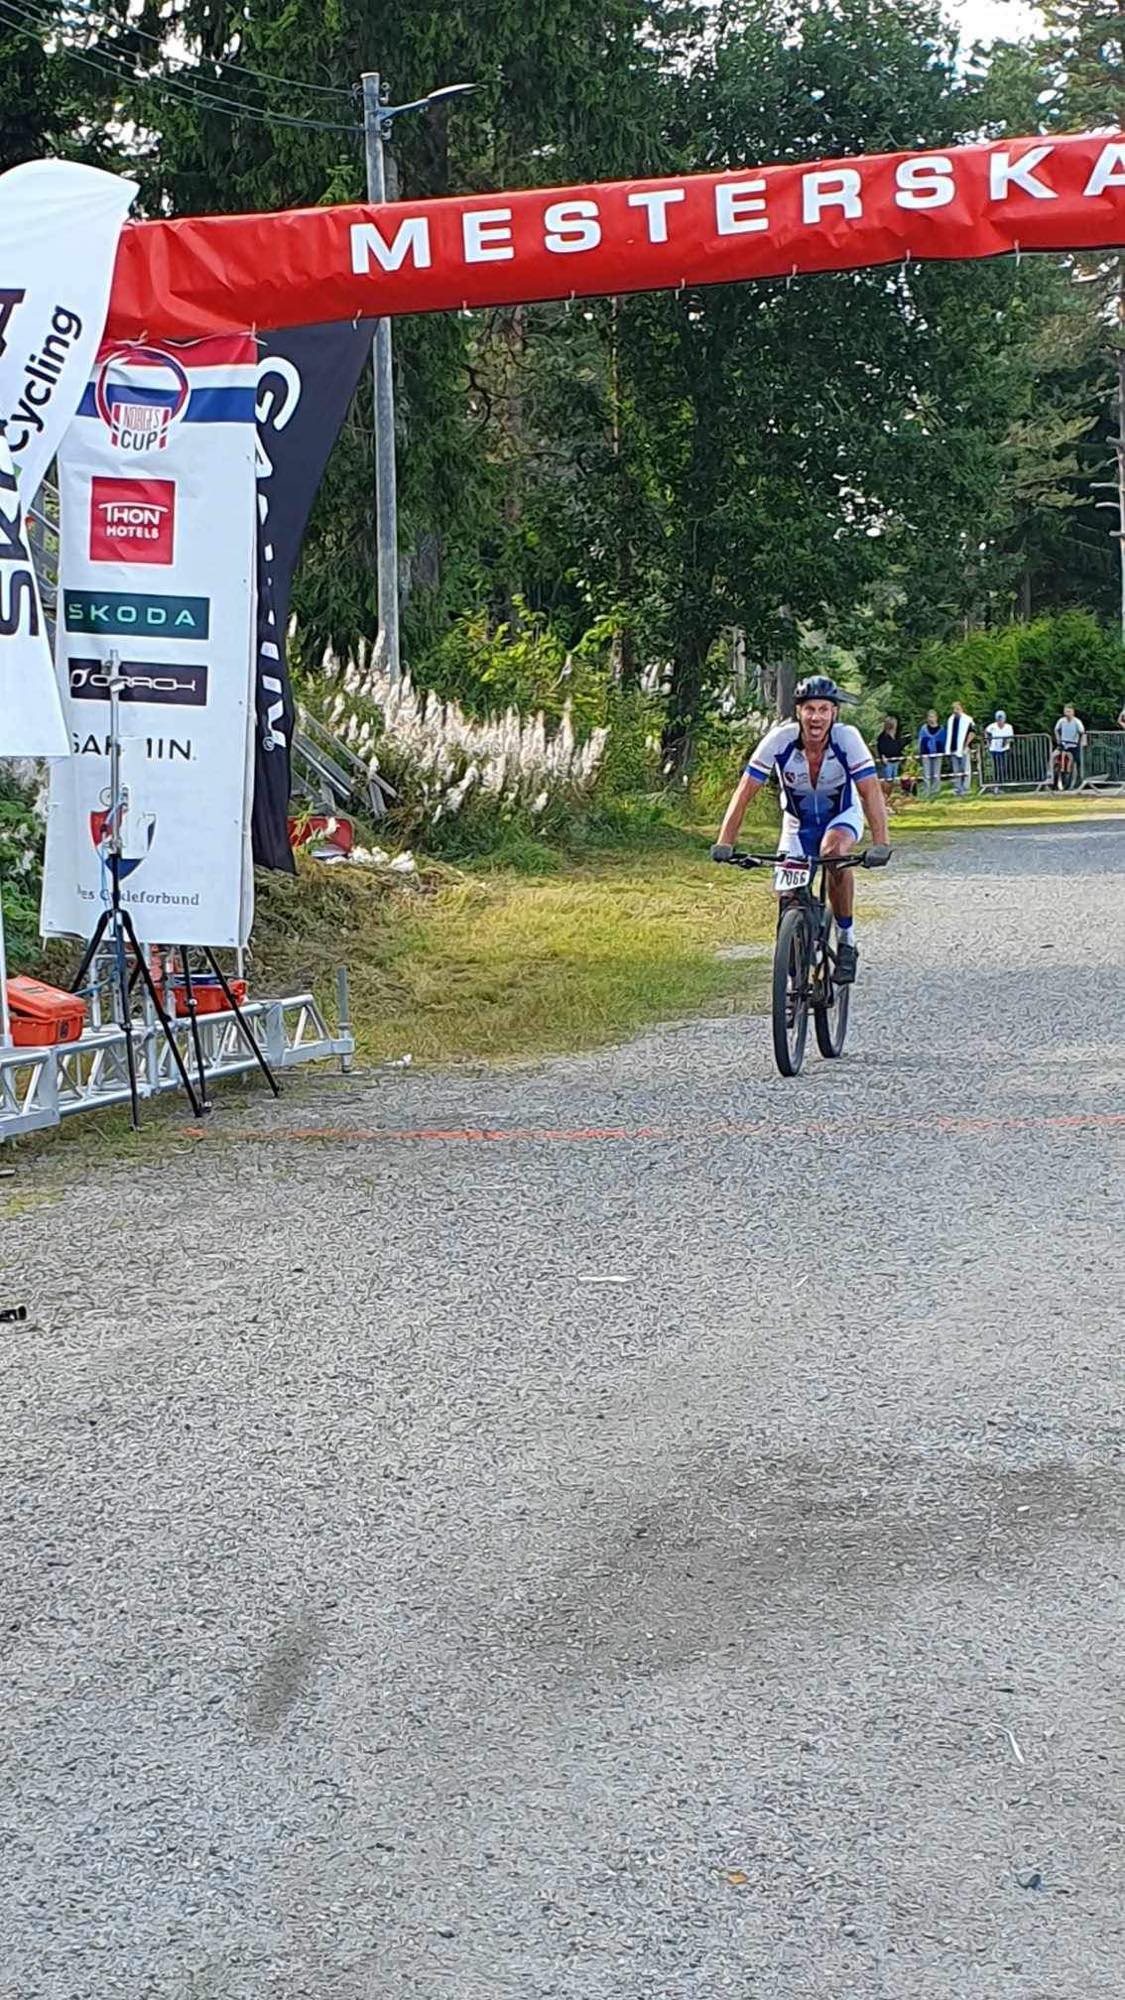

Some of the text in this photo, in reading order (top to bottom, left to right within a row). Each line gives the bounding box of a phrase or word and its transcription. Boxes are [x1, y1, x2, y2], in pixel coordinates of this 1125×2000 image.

[120, 429, 158, 450] CUP
[99, 501, 168, 525] THON
[106, 525, 159, 539] HOTELS
